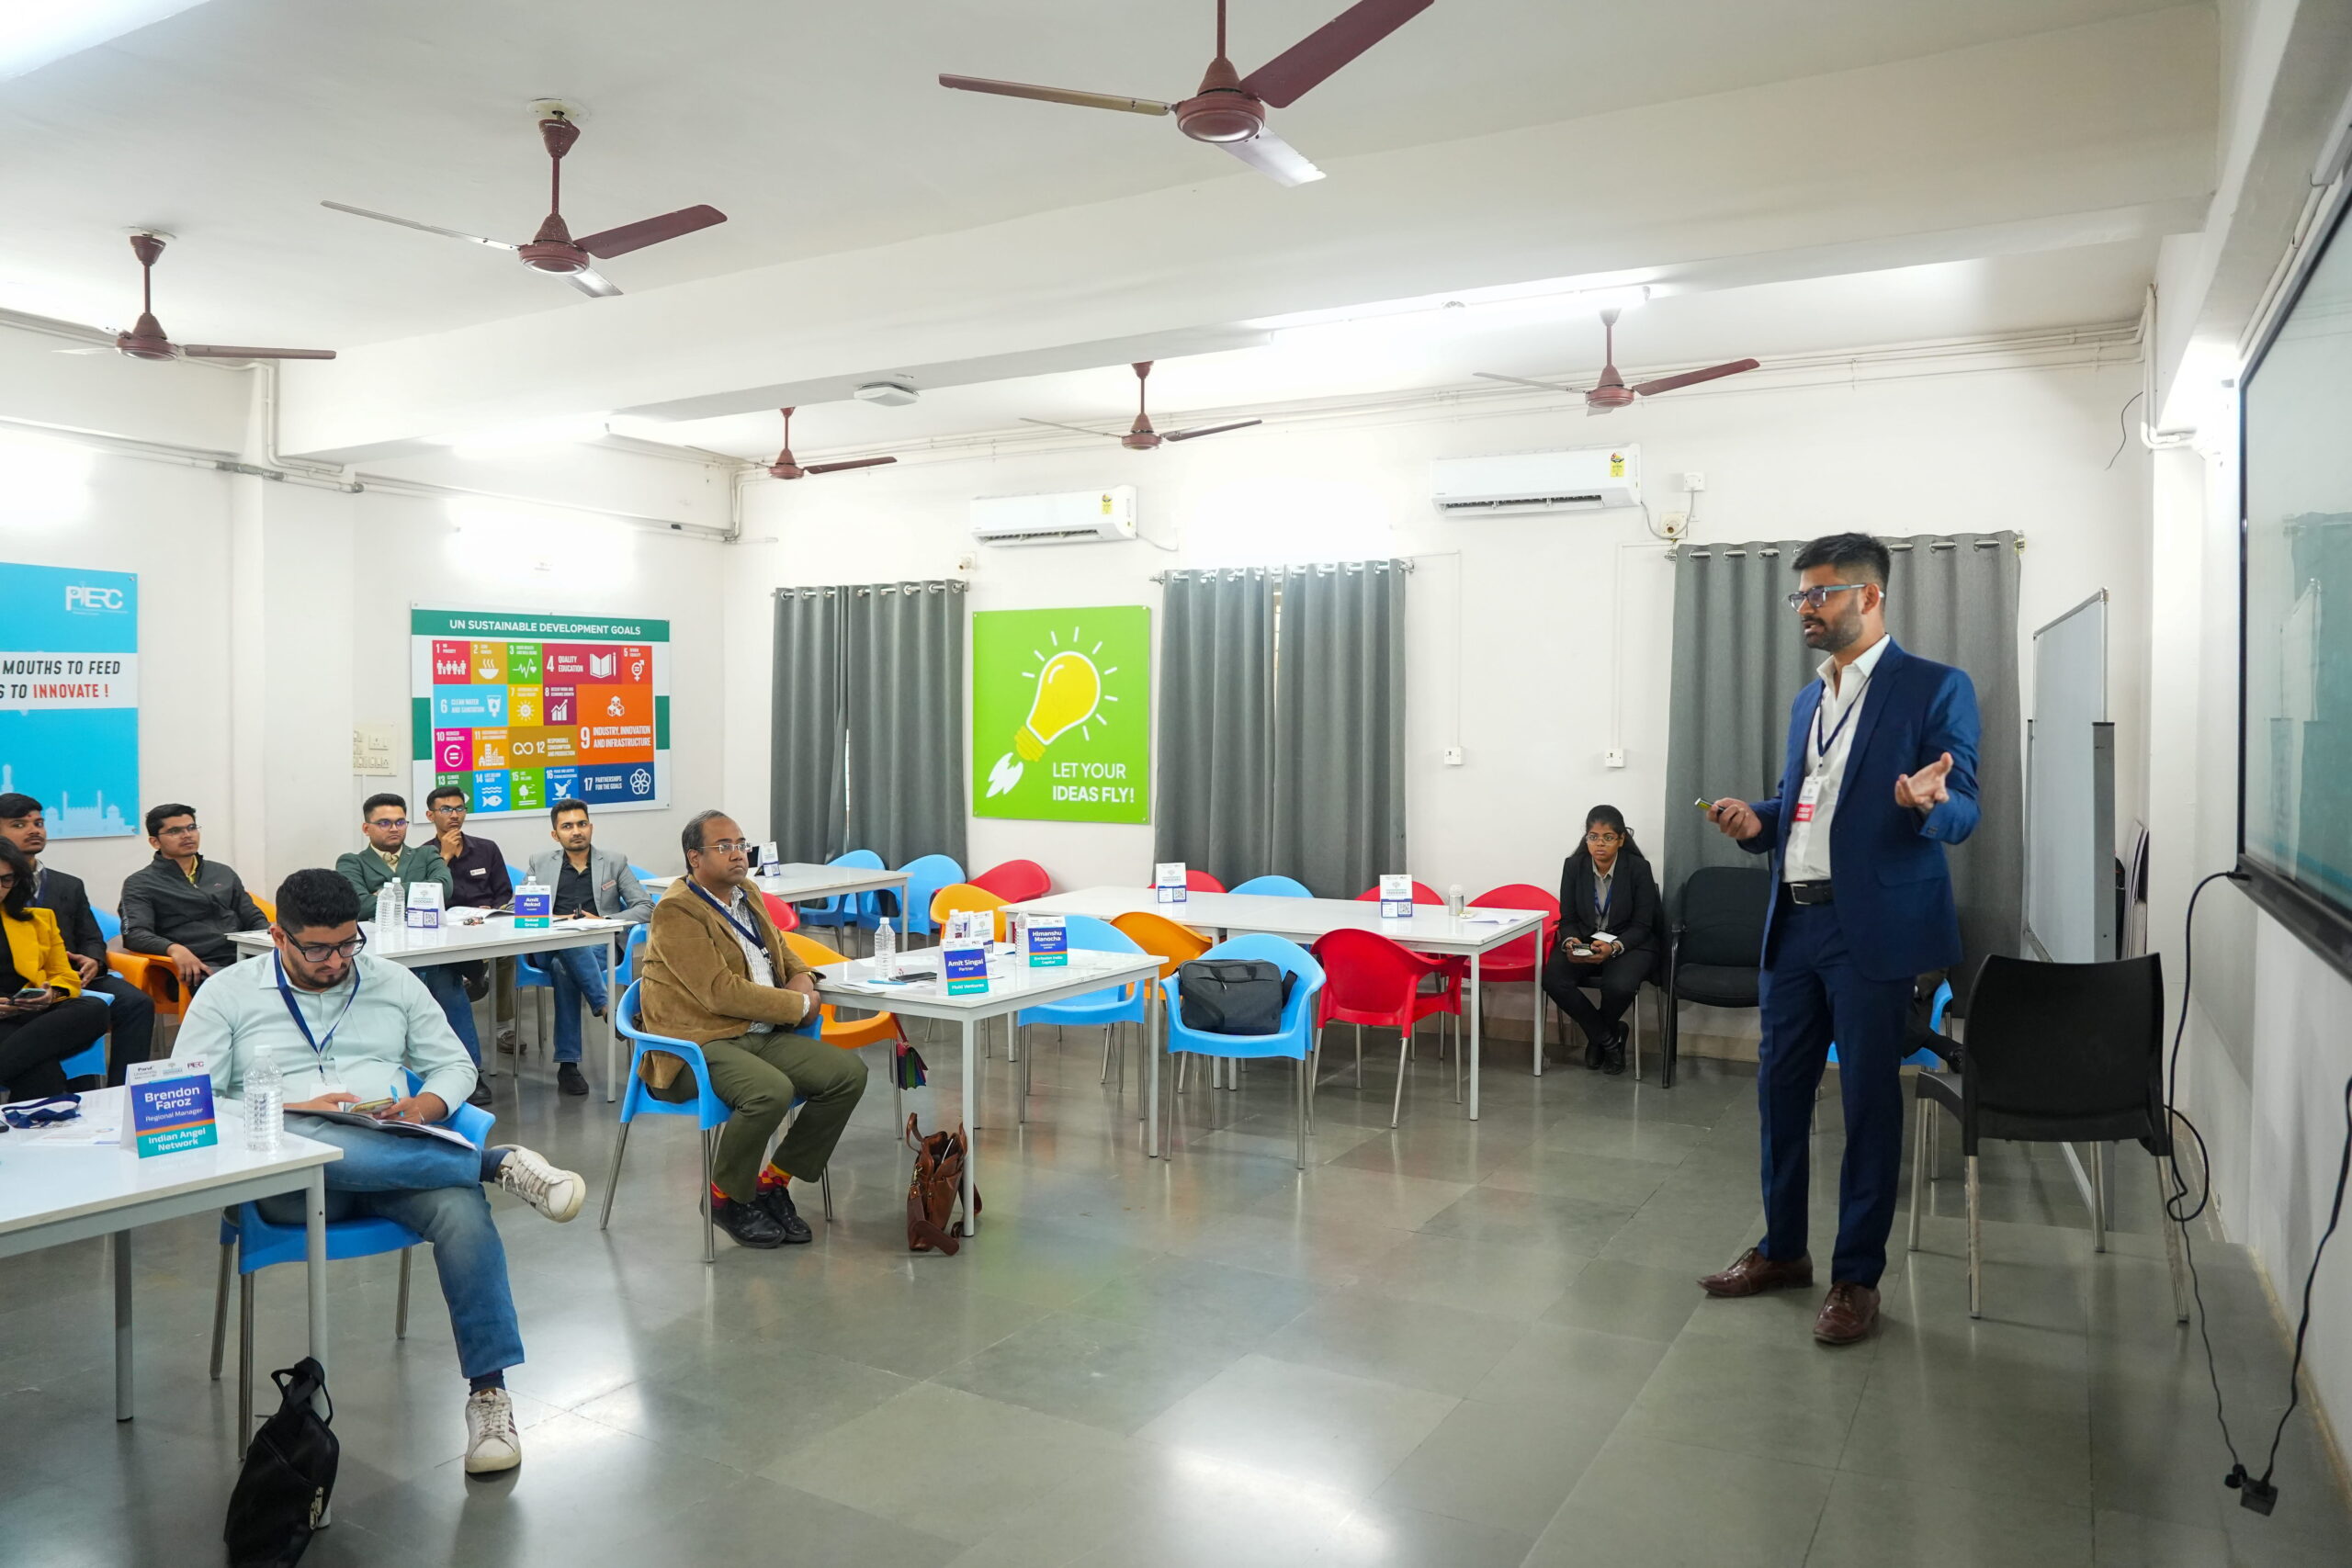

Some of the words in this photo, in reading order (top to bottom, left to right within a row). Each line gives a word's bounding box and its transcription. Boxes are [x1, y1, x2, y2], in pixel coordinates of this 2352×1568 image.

[449, 619, 466, 629] UN
[468, 619, 537, 632] SUSTAINABLE
[539, 623, 609, 634] DEVELOPMENT
[611, 625, 641, 636] GOALS
[509, 645, 514, 655] 3
[547, 655, 555, 672] 4
[558, 655, 578, 664] QUALITY
[2, 660, 62, 675] MOUTHS
[67, 660, 84, 675] TO
[89, 660, 120, 675] FEED
[11, 683, 28, 698] TO
[33, 683, 99, 698] INNOVATE
[544, 687, 549, 697] 8
[440, 699, 448, 714] 6
[580, 726, 591, 750] 9
[537, 740, 545, 754] 12
[1052, 761, 1079, 778] LET
[1080, 762, 1127, 779] YOUR
[584, 777, 594, 792] 17
[1052, 785, 1100, 802] IDEAS
[1102, 786, 1136, 804] FLY!
[144, 1087, 200, 1102] Brendon
[155, 1098, 192, 1111] Faroz
[145, 1112, 175, 1122] Regional
[175, 1108, 204, 1117] Manager
[148, 1134, 178, 1145] Indian
[179, 1127, 207, 1139] Angel
[157, 1138, 199, 1152] Network
